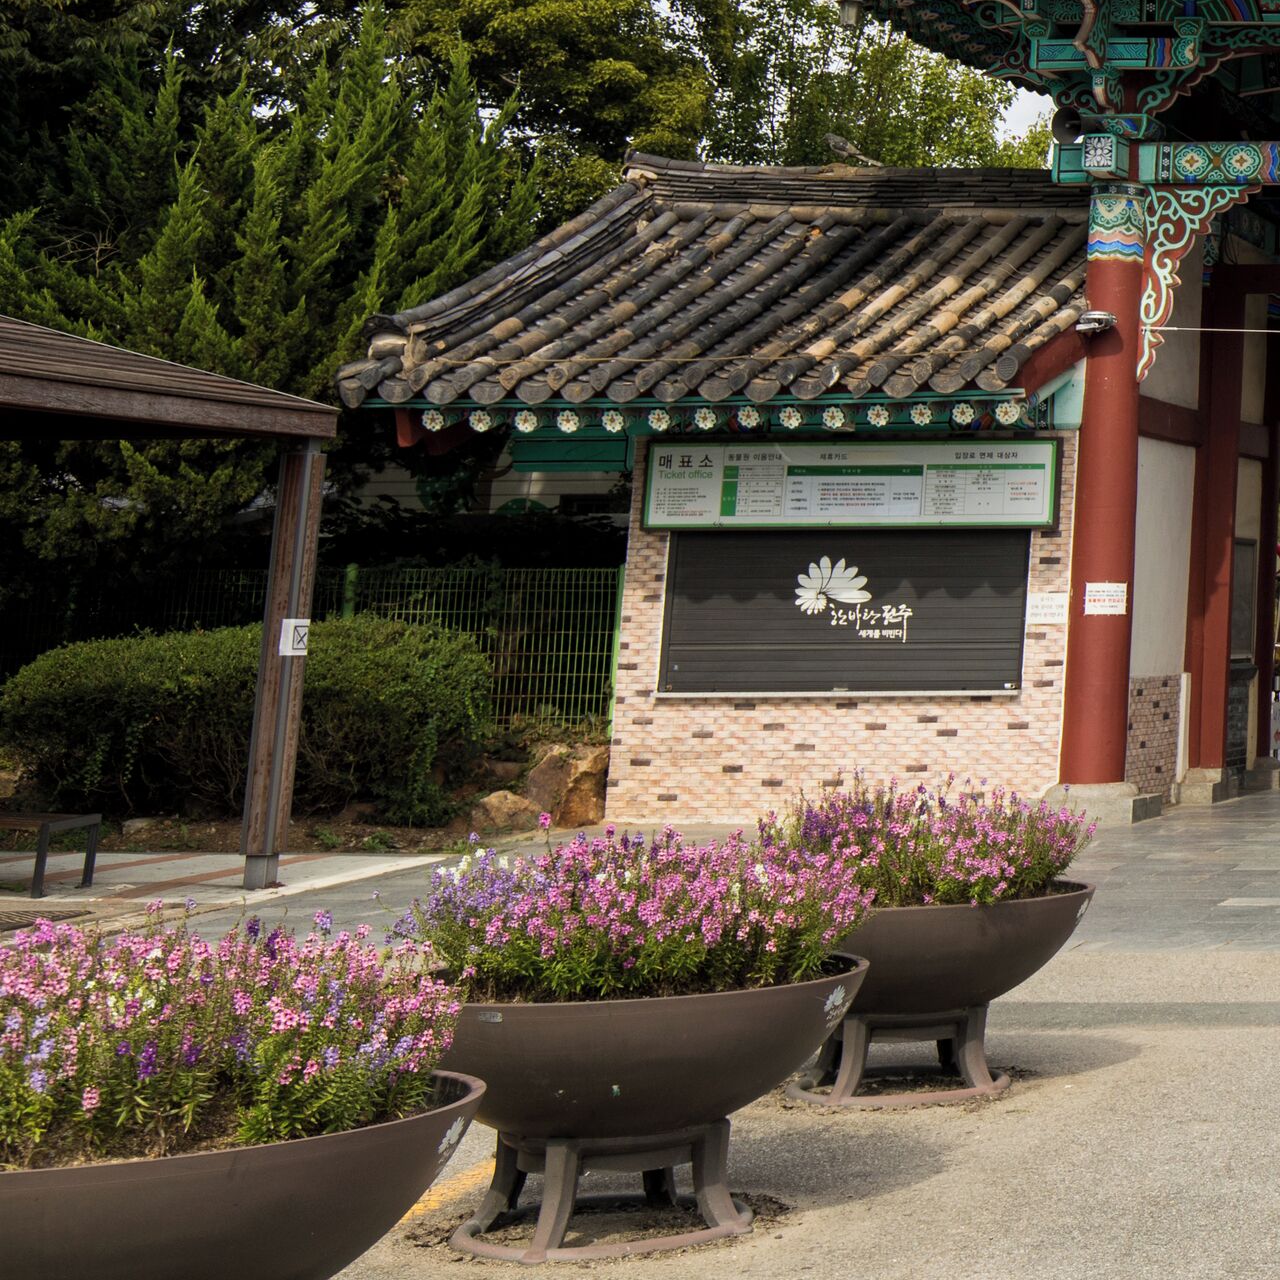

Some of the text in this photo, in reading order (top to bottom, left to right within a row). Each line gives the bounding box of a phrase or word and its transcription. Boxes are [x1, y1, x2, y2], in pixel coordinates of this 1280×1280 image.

[658, 454, 714, 469] 매표소
[659, 470, 713, 479] Ticket office
